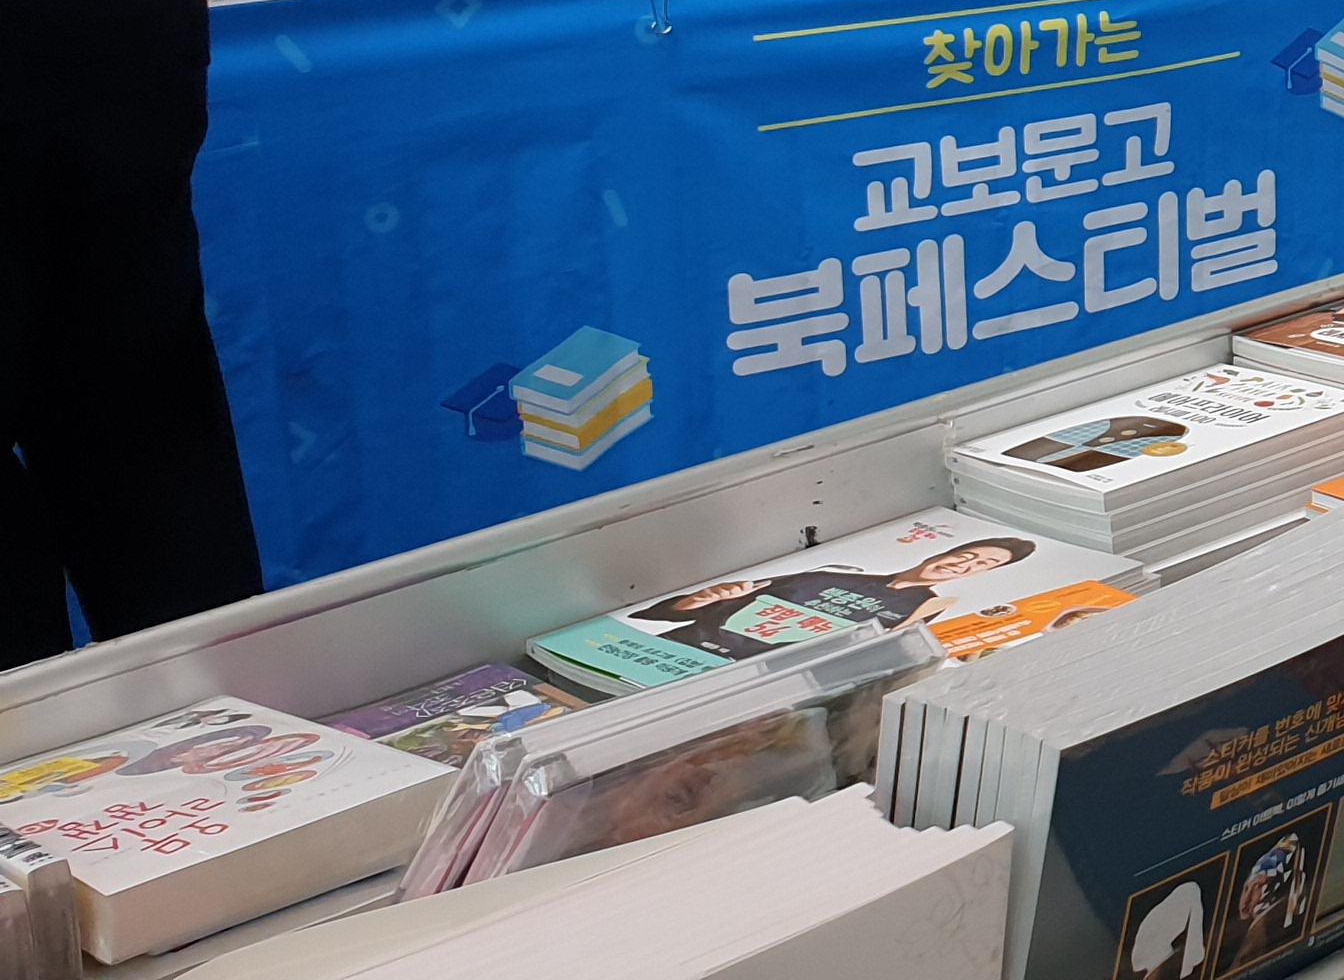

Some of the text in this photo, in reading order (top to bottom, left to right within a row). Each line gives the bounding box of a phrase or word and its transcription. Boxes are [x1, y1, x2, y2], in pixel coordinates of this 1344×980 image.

[921, 10, 1141, 90] 찾아가는
[852, 102, 1176, 233] 교보문고
[726, 168, 1279, 379] 북페스티벌
[1147, 392, 1263, 424] 에어프라이어
[743, 618, 791, 638] 54
[755, 603, 833, 634] 집밥 메뉴
[1181, 760, 1232, 795] 작품이
[1234, 733, 1300, 774] 완성되는
[1204, 723, 1269, 767] 스티커를
[1275, 700, 1322, 738] 번호에
[1220, 817, 1252, 841] 스티커
